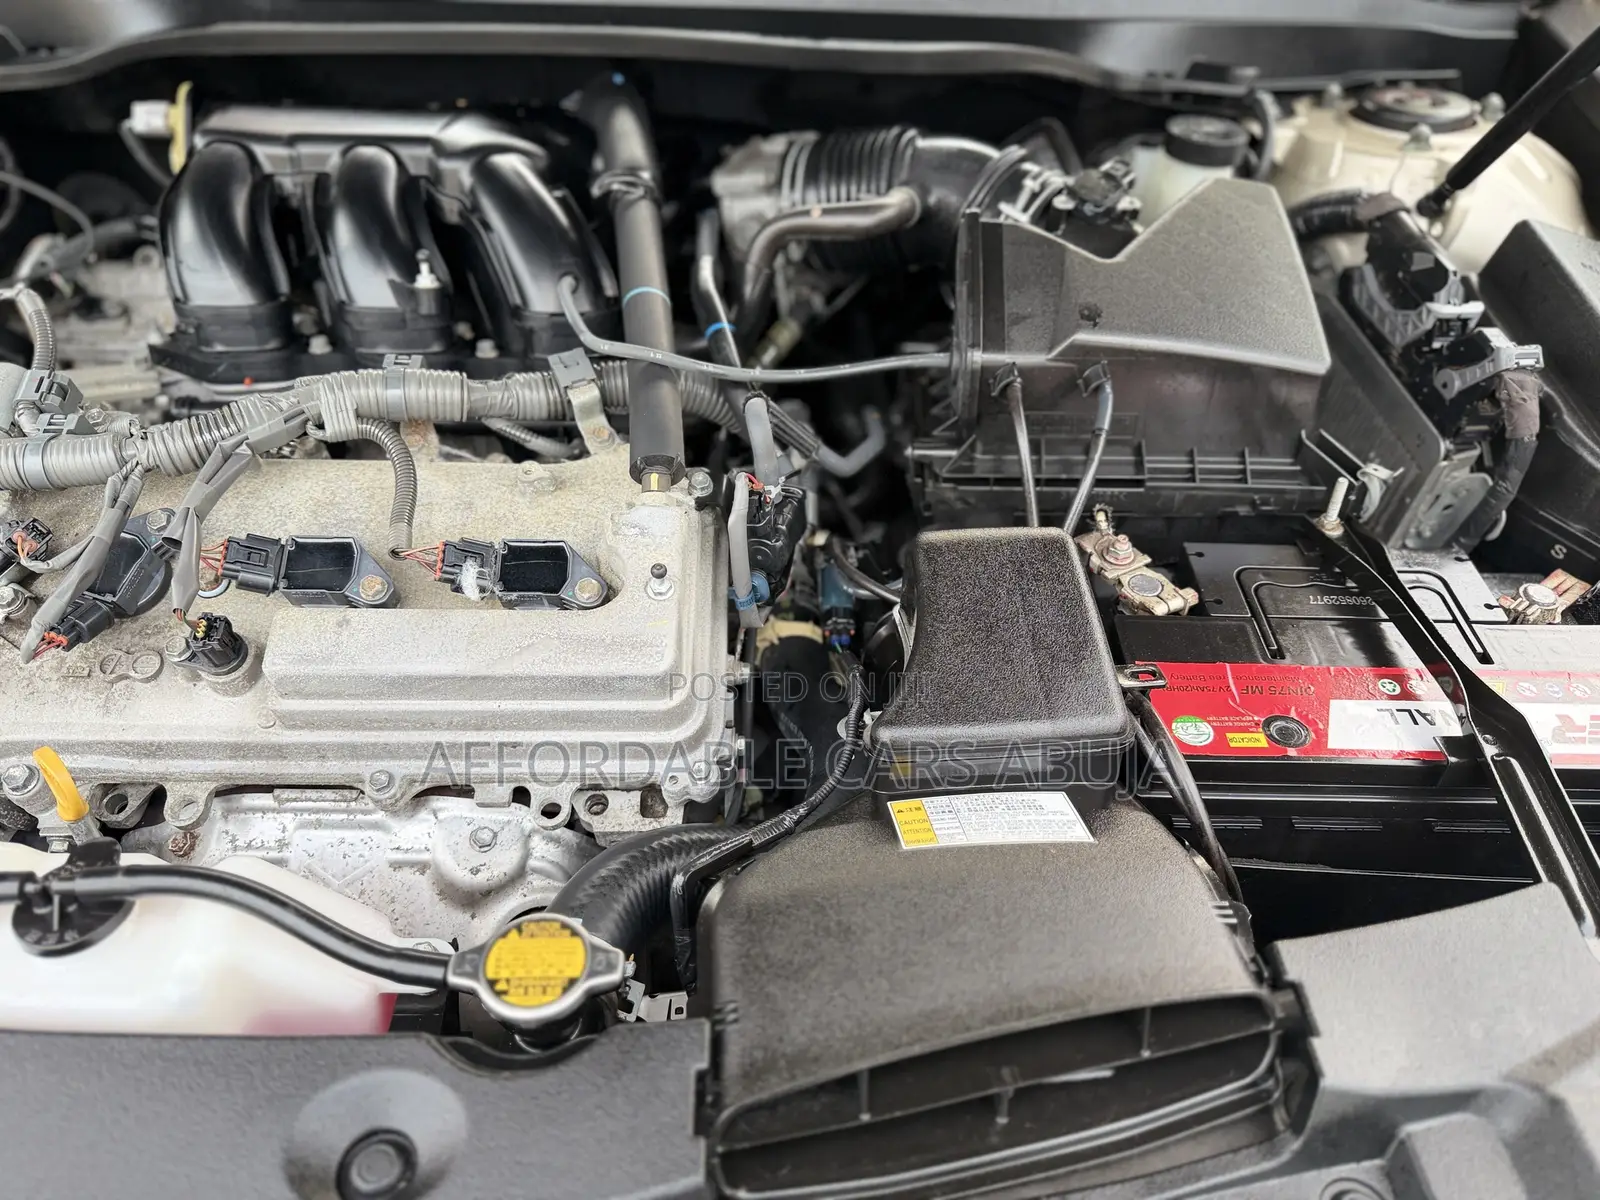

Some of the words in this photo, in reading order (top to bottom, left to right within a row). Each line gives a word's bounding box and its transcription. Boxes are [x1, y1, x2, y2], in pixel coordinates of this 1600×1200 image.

[1309, 595, 1375, 606] 260852977
[1170, 673, 1206, 682] Battery
[1209, 673, 1300, 683] Maintenance-ree
[1240, 684, 1264, 695] MF
[1228, 736, 1262, 744] INDICATOR
[899, 818, 928, 826] CAUTION
